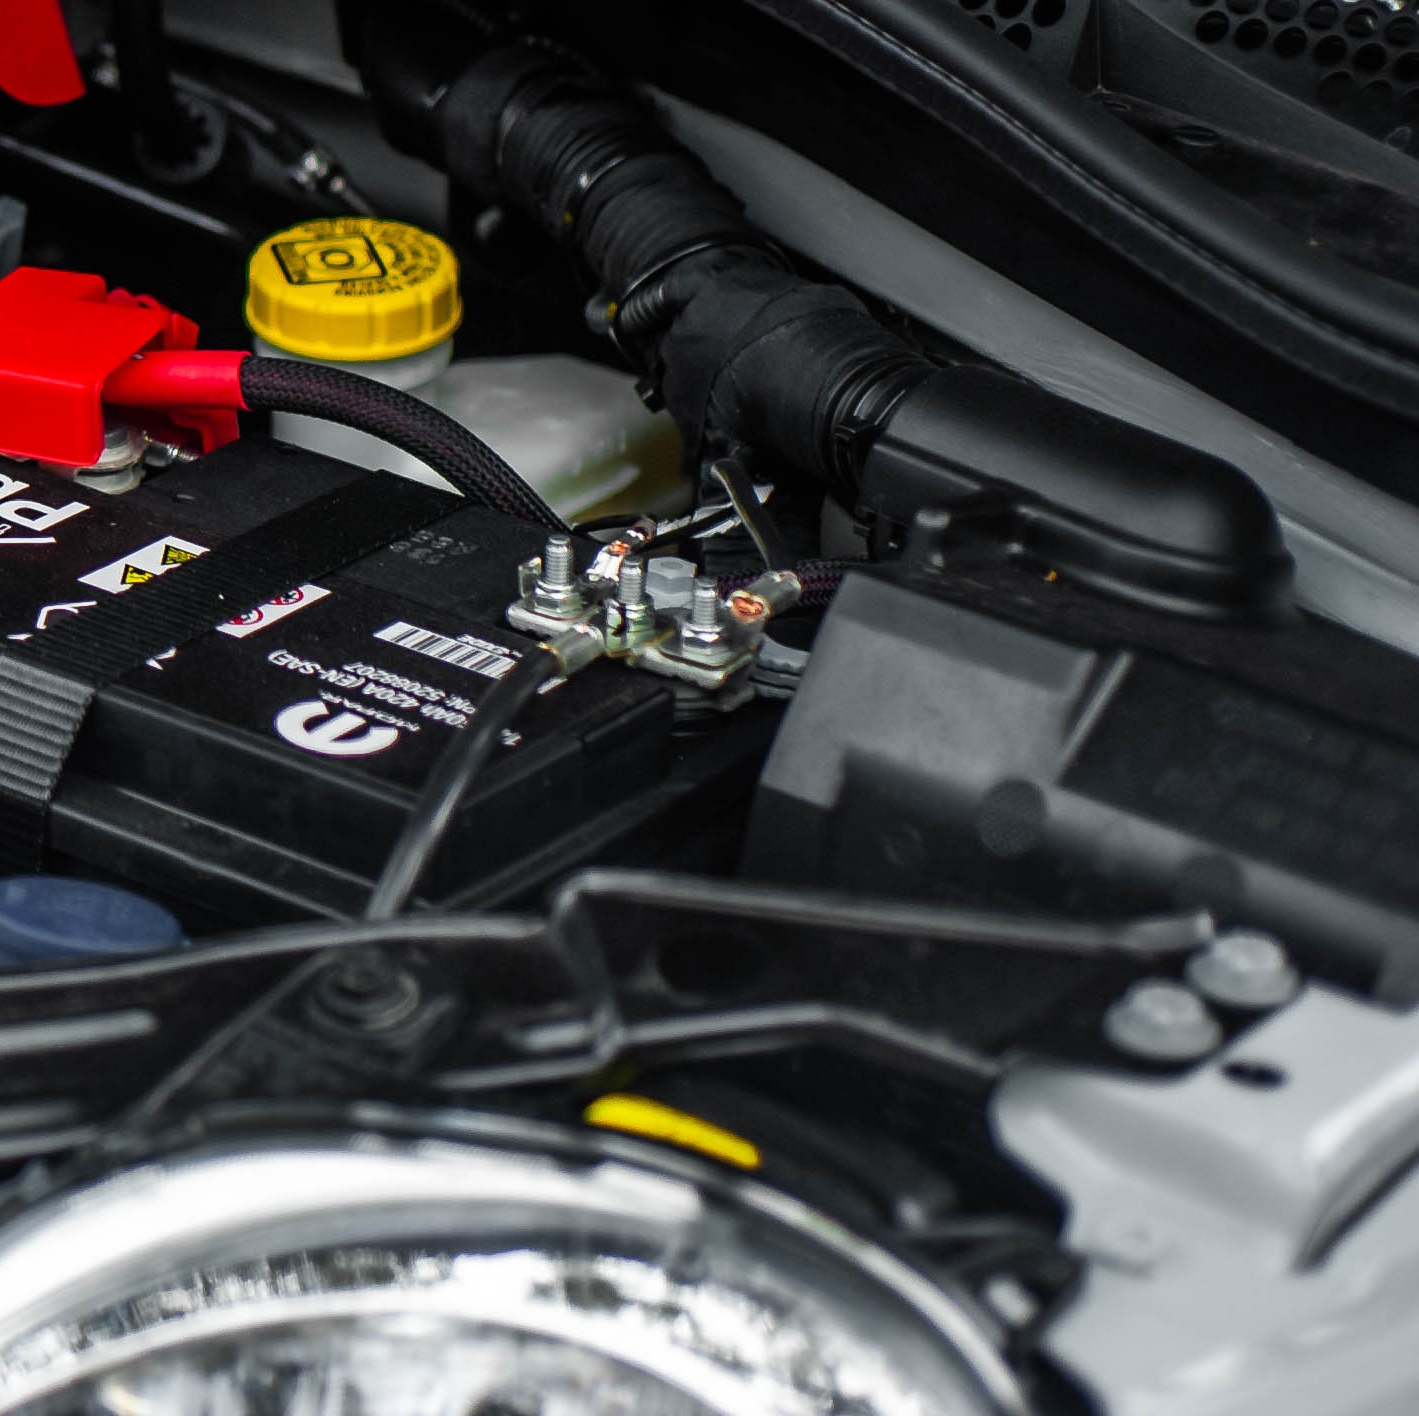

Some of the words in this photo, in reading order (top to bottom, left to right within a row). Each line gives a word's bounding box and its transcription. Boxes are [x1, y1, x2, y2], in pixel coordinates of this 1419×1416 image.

[267, 649, 366, 692] (EN-SAE)
[342, 661, 444, 704] 52088207
[361, 680, 420, 710] 420A
[420, 703, 468, 730] 0Ah
